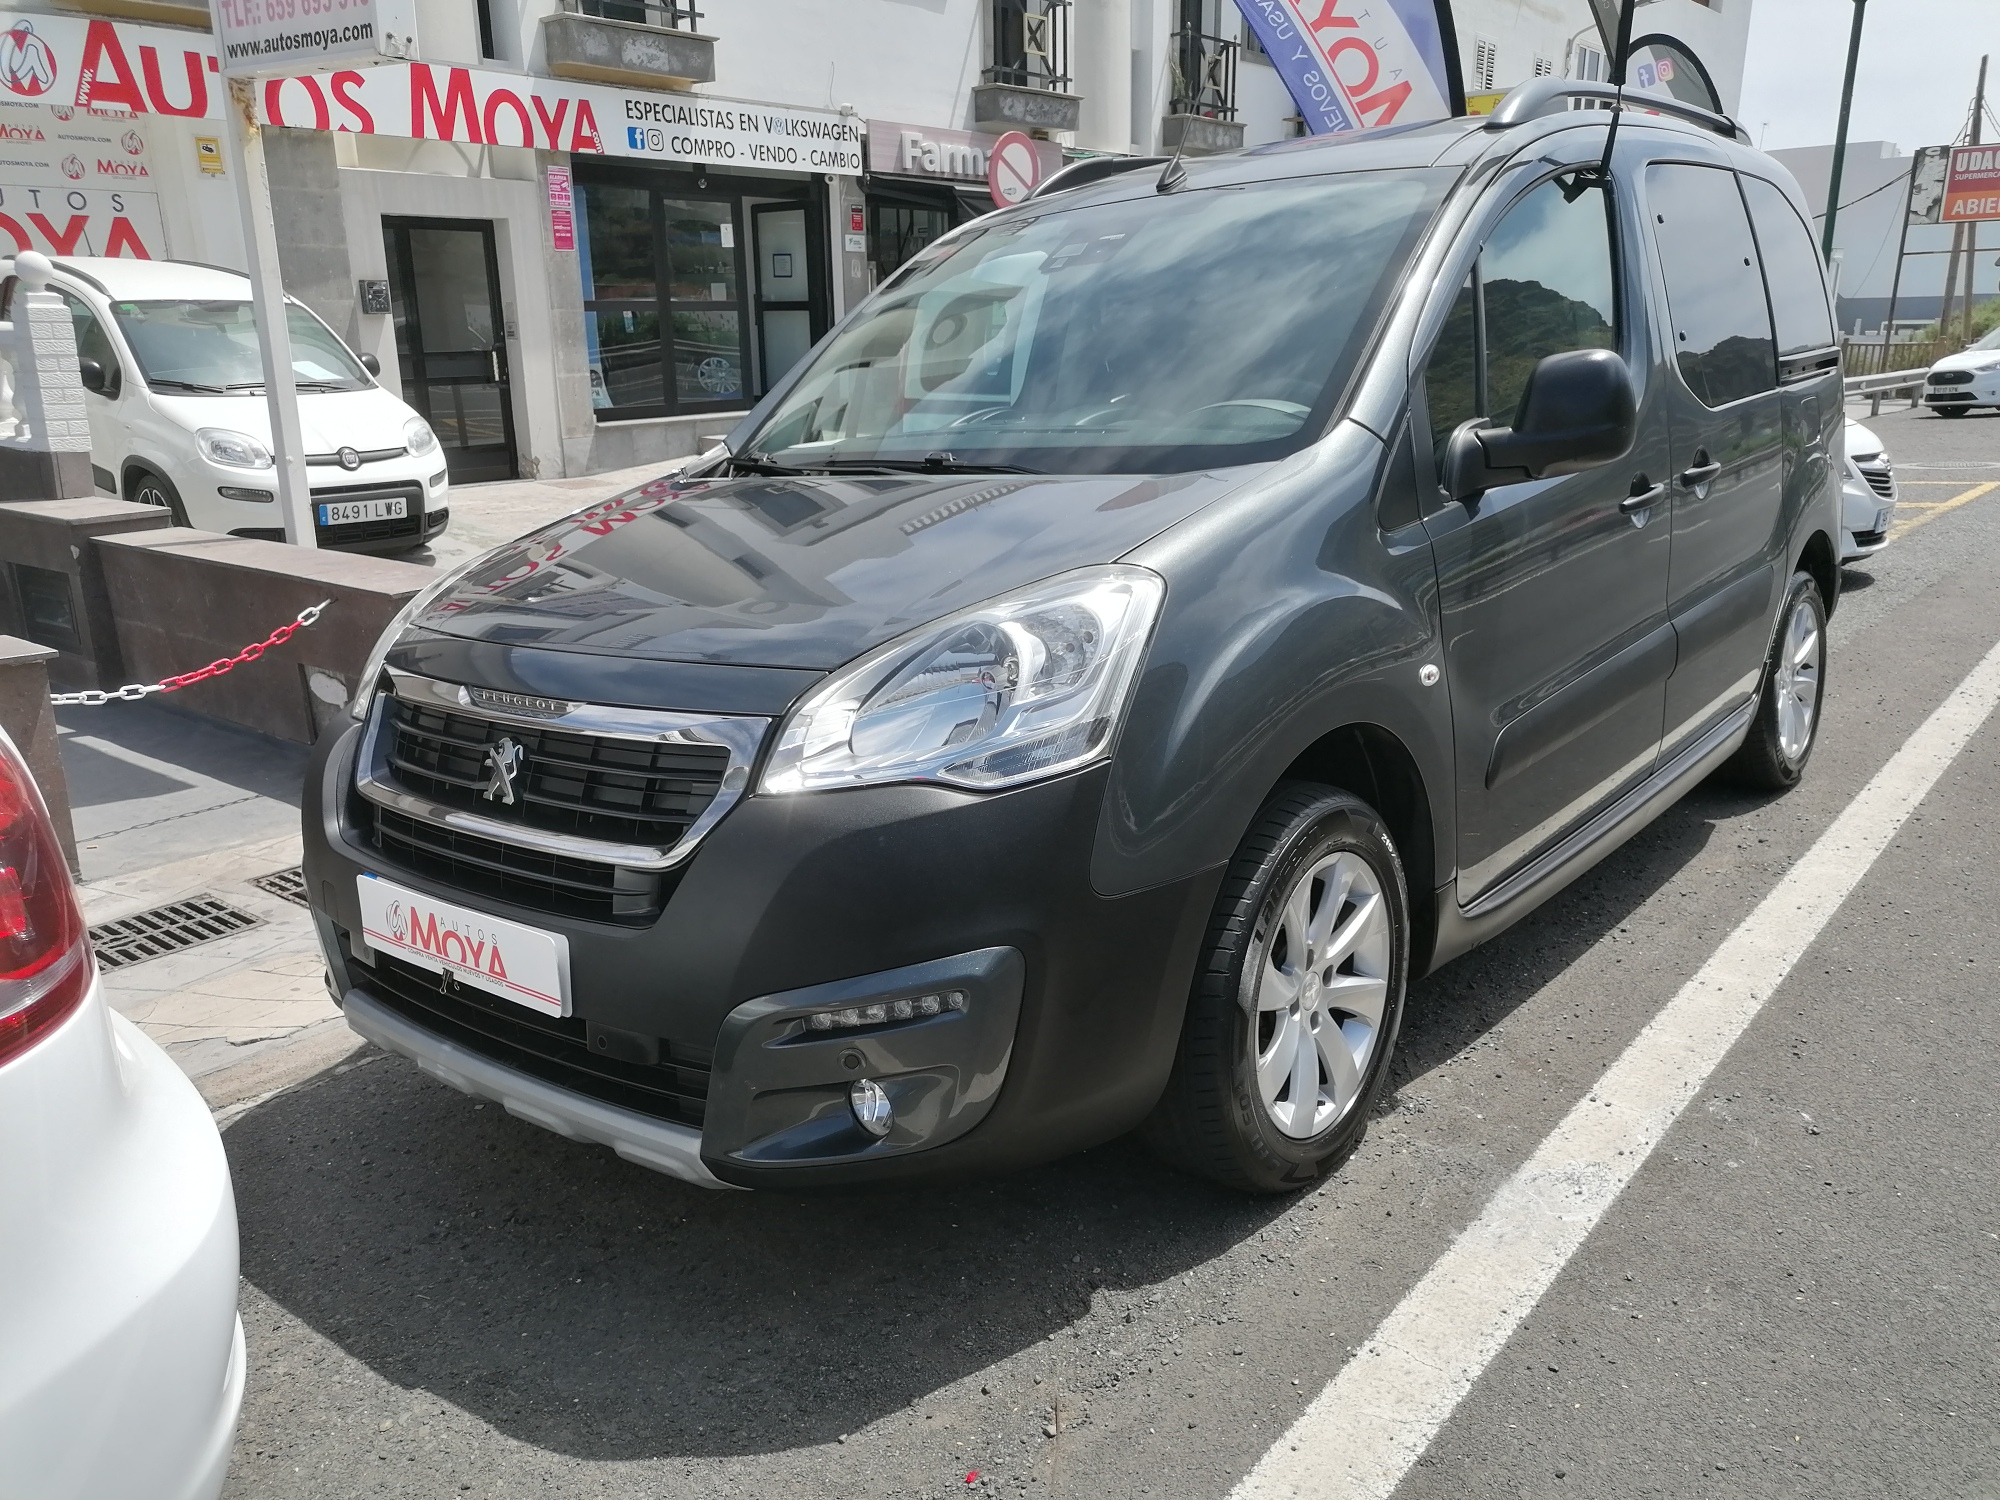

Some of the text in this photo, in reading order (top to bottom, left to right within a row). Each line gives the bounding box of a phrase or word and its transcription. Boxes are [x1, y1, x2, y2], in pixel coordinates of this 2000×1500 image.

[227, 22, 374, 58] www.autosmoya.com
[74, 19, 605, 154] AUOS MOYA
[78, 68, 94, 104] www.
[625, 99, 735, 131] ESPECIALISTAS
[739, 113, 759, 133] EN
[57, 134, 112, 143] AUTOSMOYA.COM
[589, 128, 603, 154] .com
[671, 136, 735, 159] COMPRO
[749, 144, 798, 165] VENDO
[810, 150, 860, 170] CAMBIO
[901, 132, 990, 176] Farm
[97, 158, 149, 176] MOYA
[331, 501, 402, 521] 8491 LWG
[482, 690, 558, 711] PEUGEOT
[410, 906, 508, 980] MOYA
[440, 917, 497, 945] AUTOS
[407, 947, 425, 959] COMPRA
[425, 953, 438, 963] VENTA
[463, 968, 481, 979] NUEVOS
[485, 977, 504, 988] USADOS
